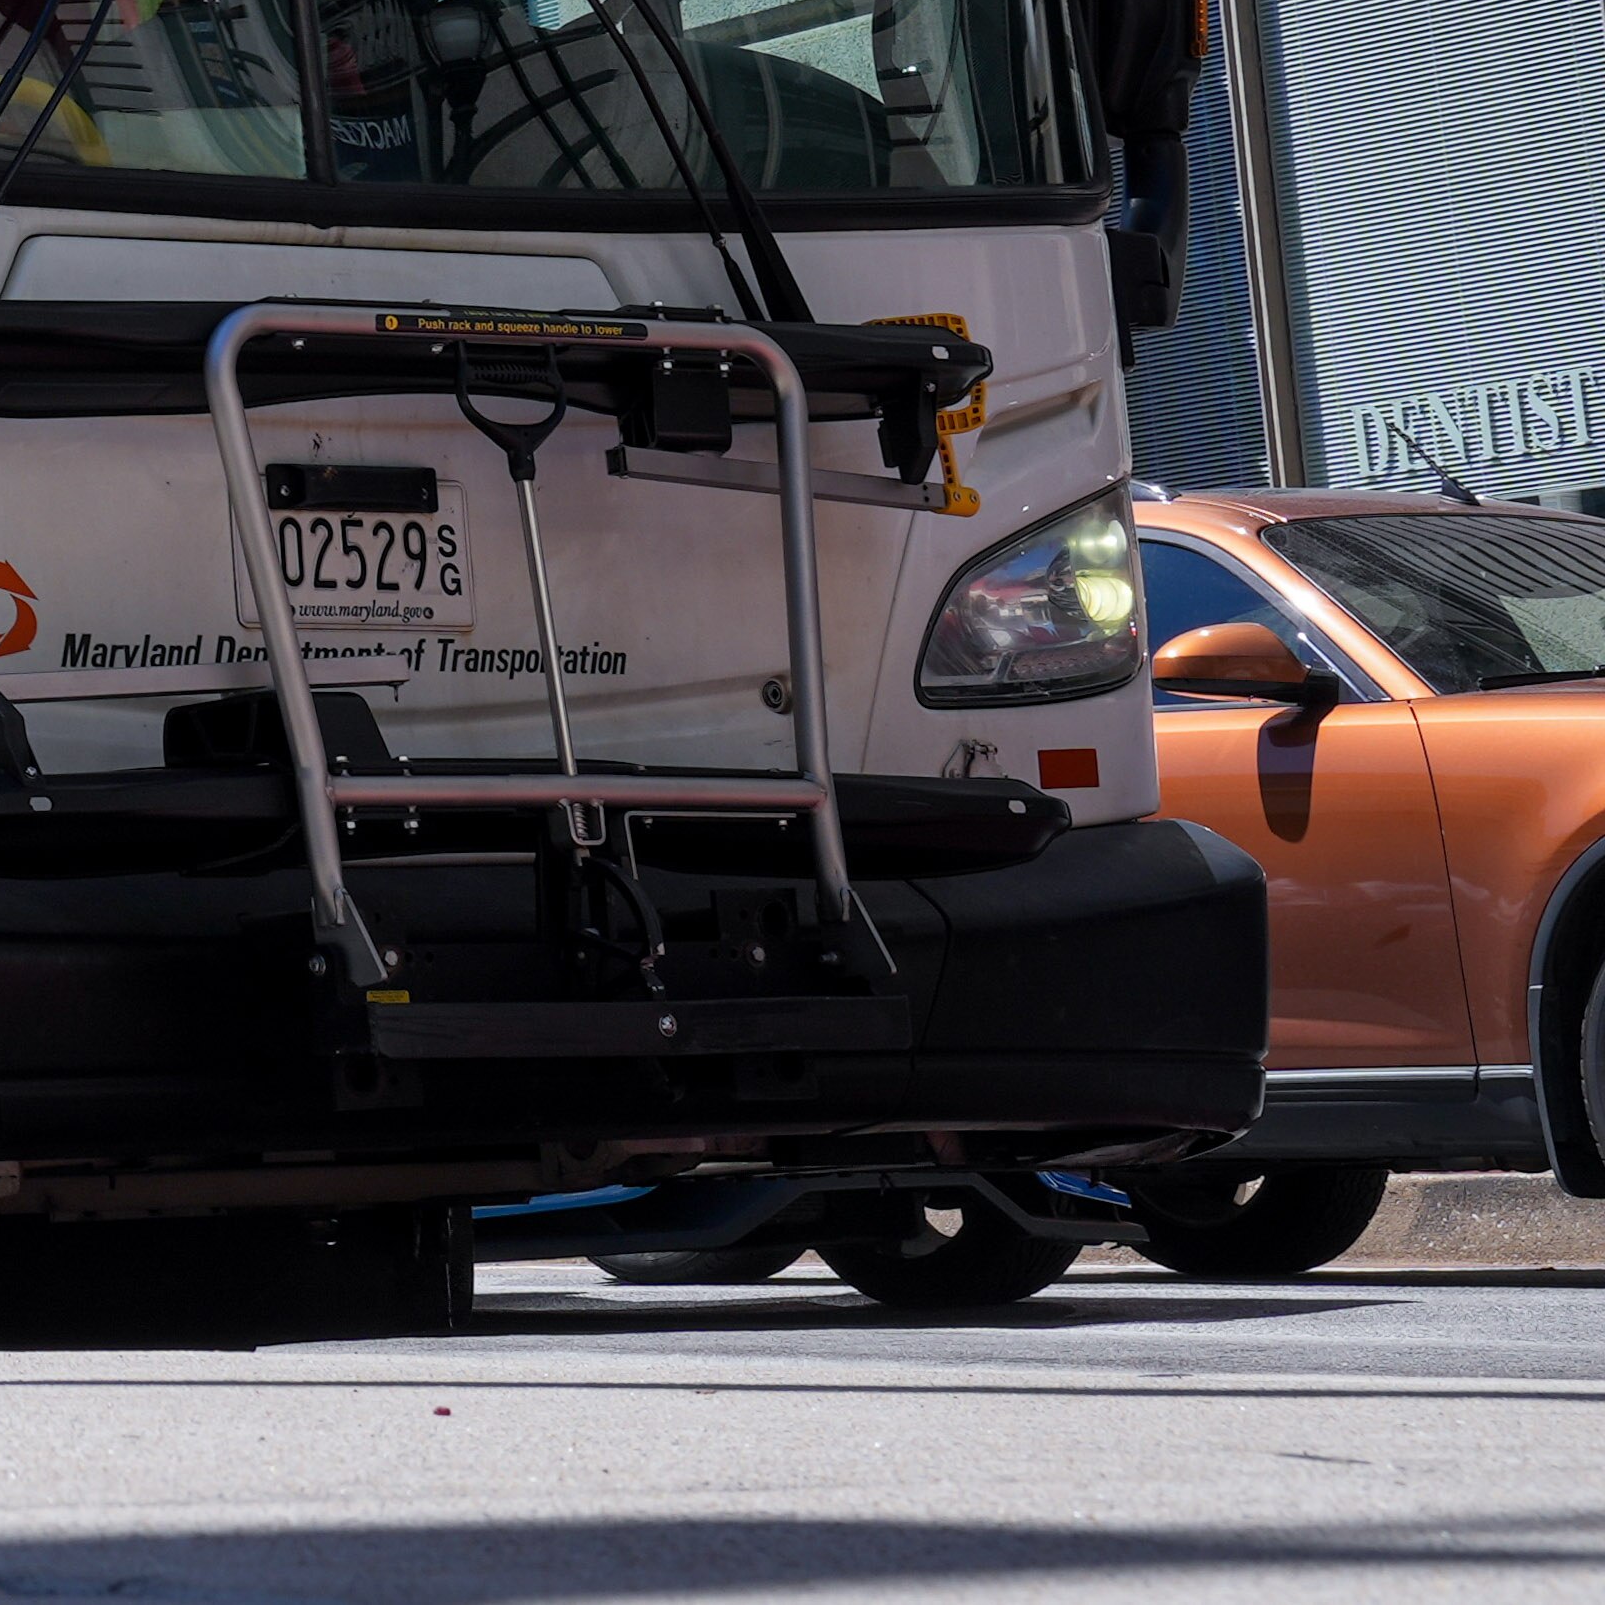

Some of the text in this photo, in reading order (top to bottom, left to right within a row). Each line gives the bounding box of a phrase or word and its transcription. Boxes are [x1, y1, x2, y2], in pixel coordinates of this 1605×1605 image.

[418, 318, 445, 331] Push
[448, 319, 472, 331] rack
[474, 319, 493, 332] and
[497, 321, 539, 336] squeeze
[542, 321, 578, 335] handle
[580, 323, 592, 335] to
[594, 324, 624, 336] lower
[1349, 365, 1599, 478] DENTIST
[278, 516, 427, 591] 02529
[298, 600, 423, 623] www.maryland.gov
[60, 632, 201, 669] Maryland
[436, 639, 627, 679] Transpotation
